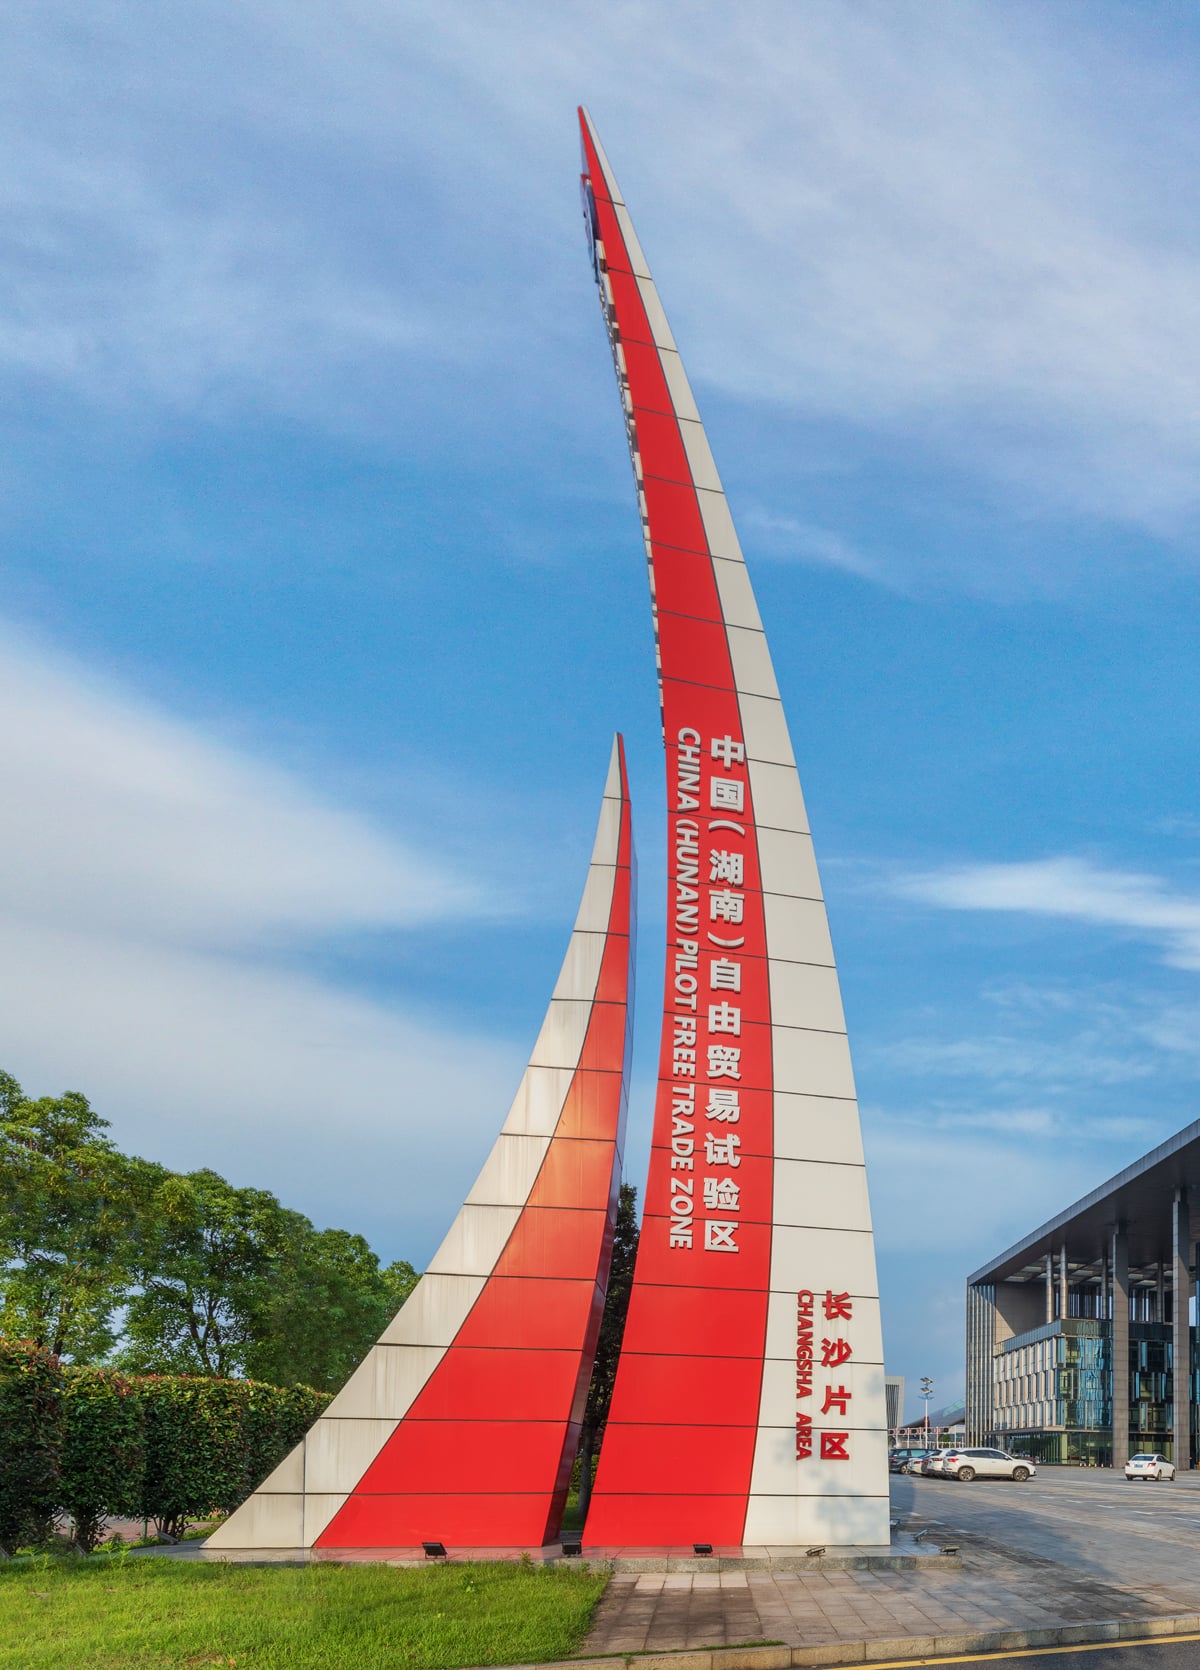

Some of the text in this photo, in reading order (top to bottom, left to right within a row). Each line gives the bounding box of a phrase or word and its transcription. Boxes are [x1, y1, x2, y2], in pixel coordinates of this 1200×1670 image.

[669, 727, 701, 1250] CHINA (HUNAN) PILOT FREE TRADE ZONE
[703, 734, 746, 1254] 中国（湖南）自由贸易试验区
[795, 1289, 814, 1461] CHANGSHA AREA
[820, 1289, 853, 1461] 长沙片区
